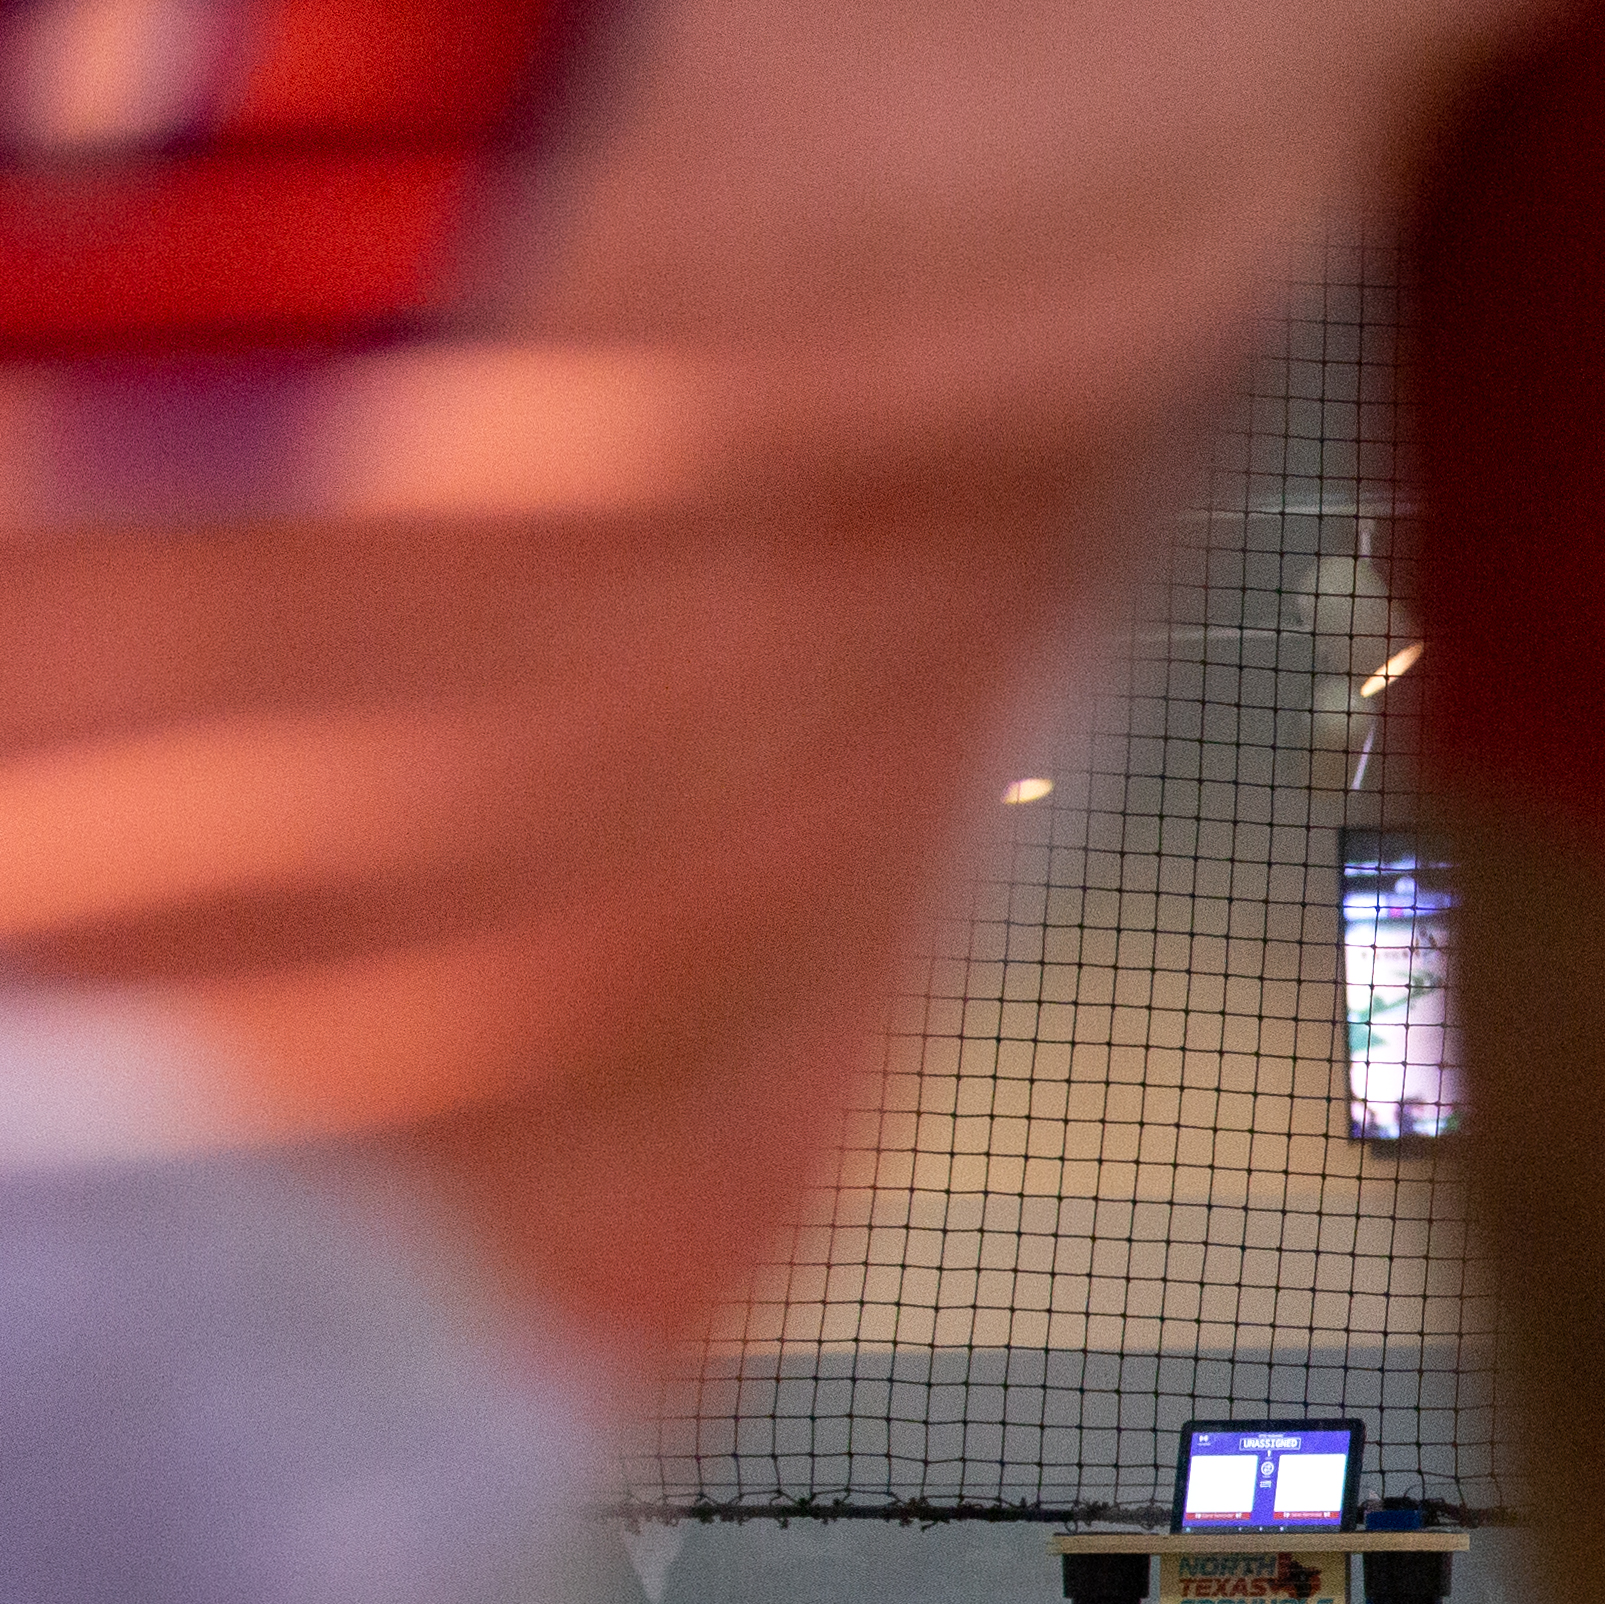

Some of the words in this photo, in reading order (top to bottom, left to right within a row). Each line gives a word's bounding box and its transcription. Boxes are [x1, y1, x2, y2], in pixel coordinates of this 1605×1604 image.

[1243, 1438, 1298, 1449] UNASSIGNED
[1179, 1556, 1278, 1577] NORTH
[1179, 1577, 1270, 1597] TEXAS
